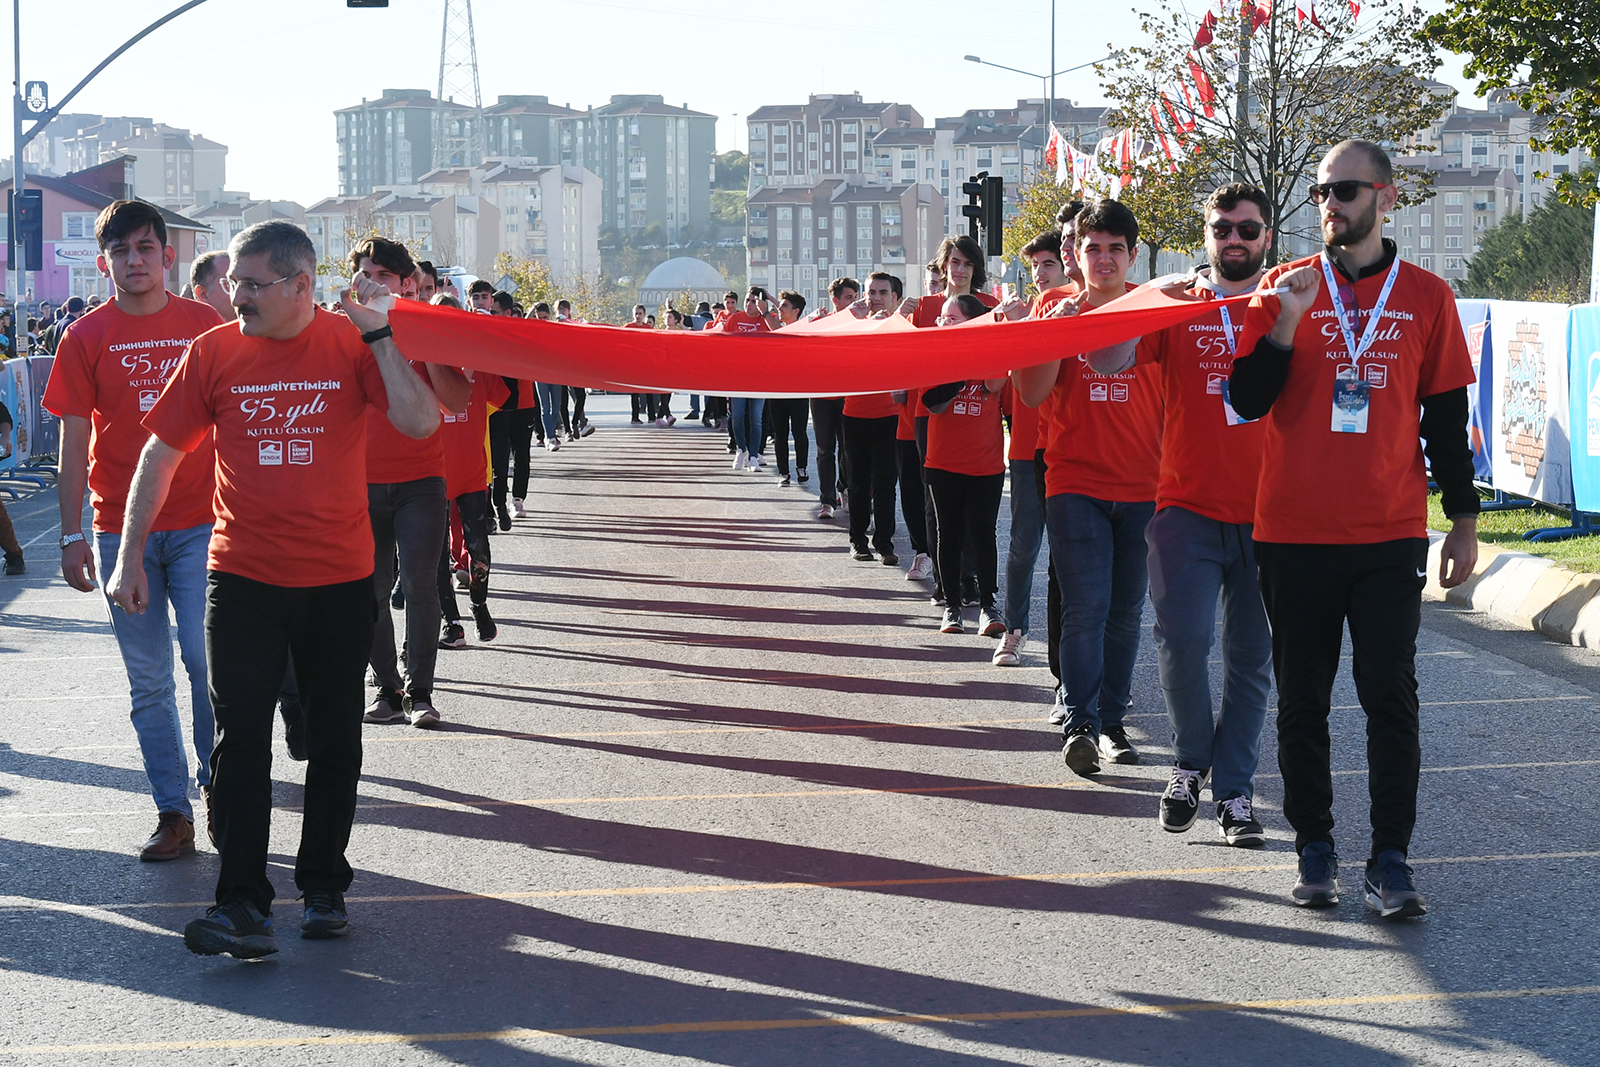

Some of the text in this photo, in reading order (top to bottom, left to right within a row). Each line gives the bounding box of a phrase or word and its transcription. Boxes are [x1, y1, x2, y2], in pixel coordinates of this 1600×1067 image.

[1363, 350, 1398, 360] OLSUN
[1199, 362, 1231, 370] KUTLU
[129, 378, 160, 388] KUTLU
[230, 380, 341, 394] CUMHURİYETİMİZİN
[247, 426, 324, 437] KUTLU OLSUN
